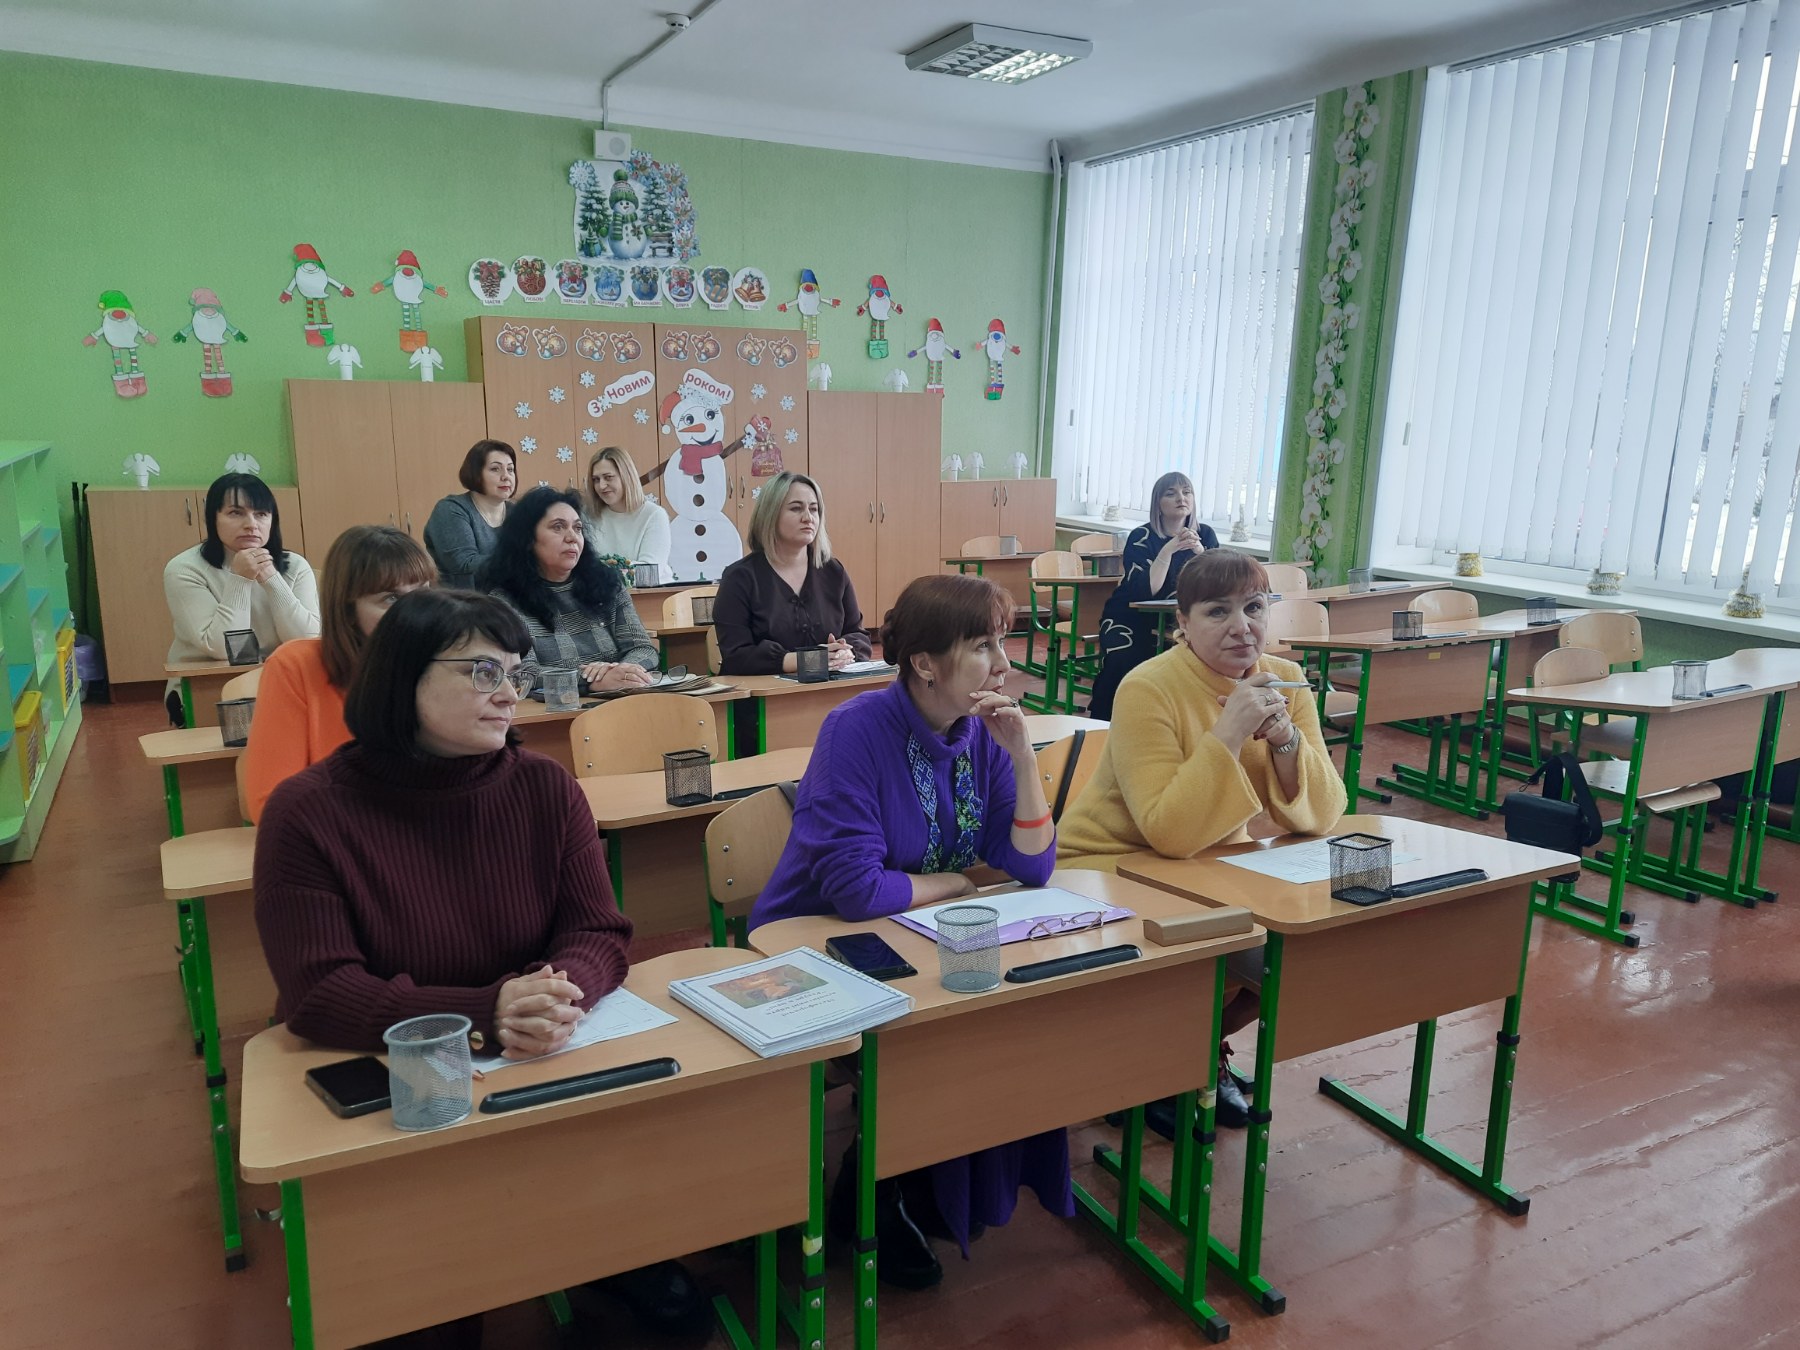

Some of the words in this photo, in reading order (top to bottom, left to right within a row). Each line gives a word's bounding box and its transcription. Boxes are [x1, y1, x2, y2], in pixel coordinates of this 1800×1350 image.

[590, 402, 601, 414] З
[606, 375, 651, 400] Новим
[685, 373, 732, 401] роком!
